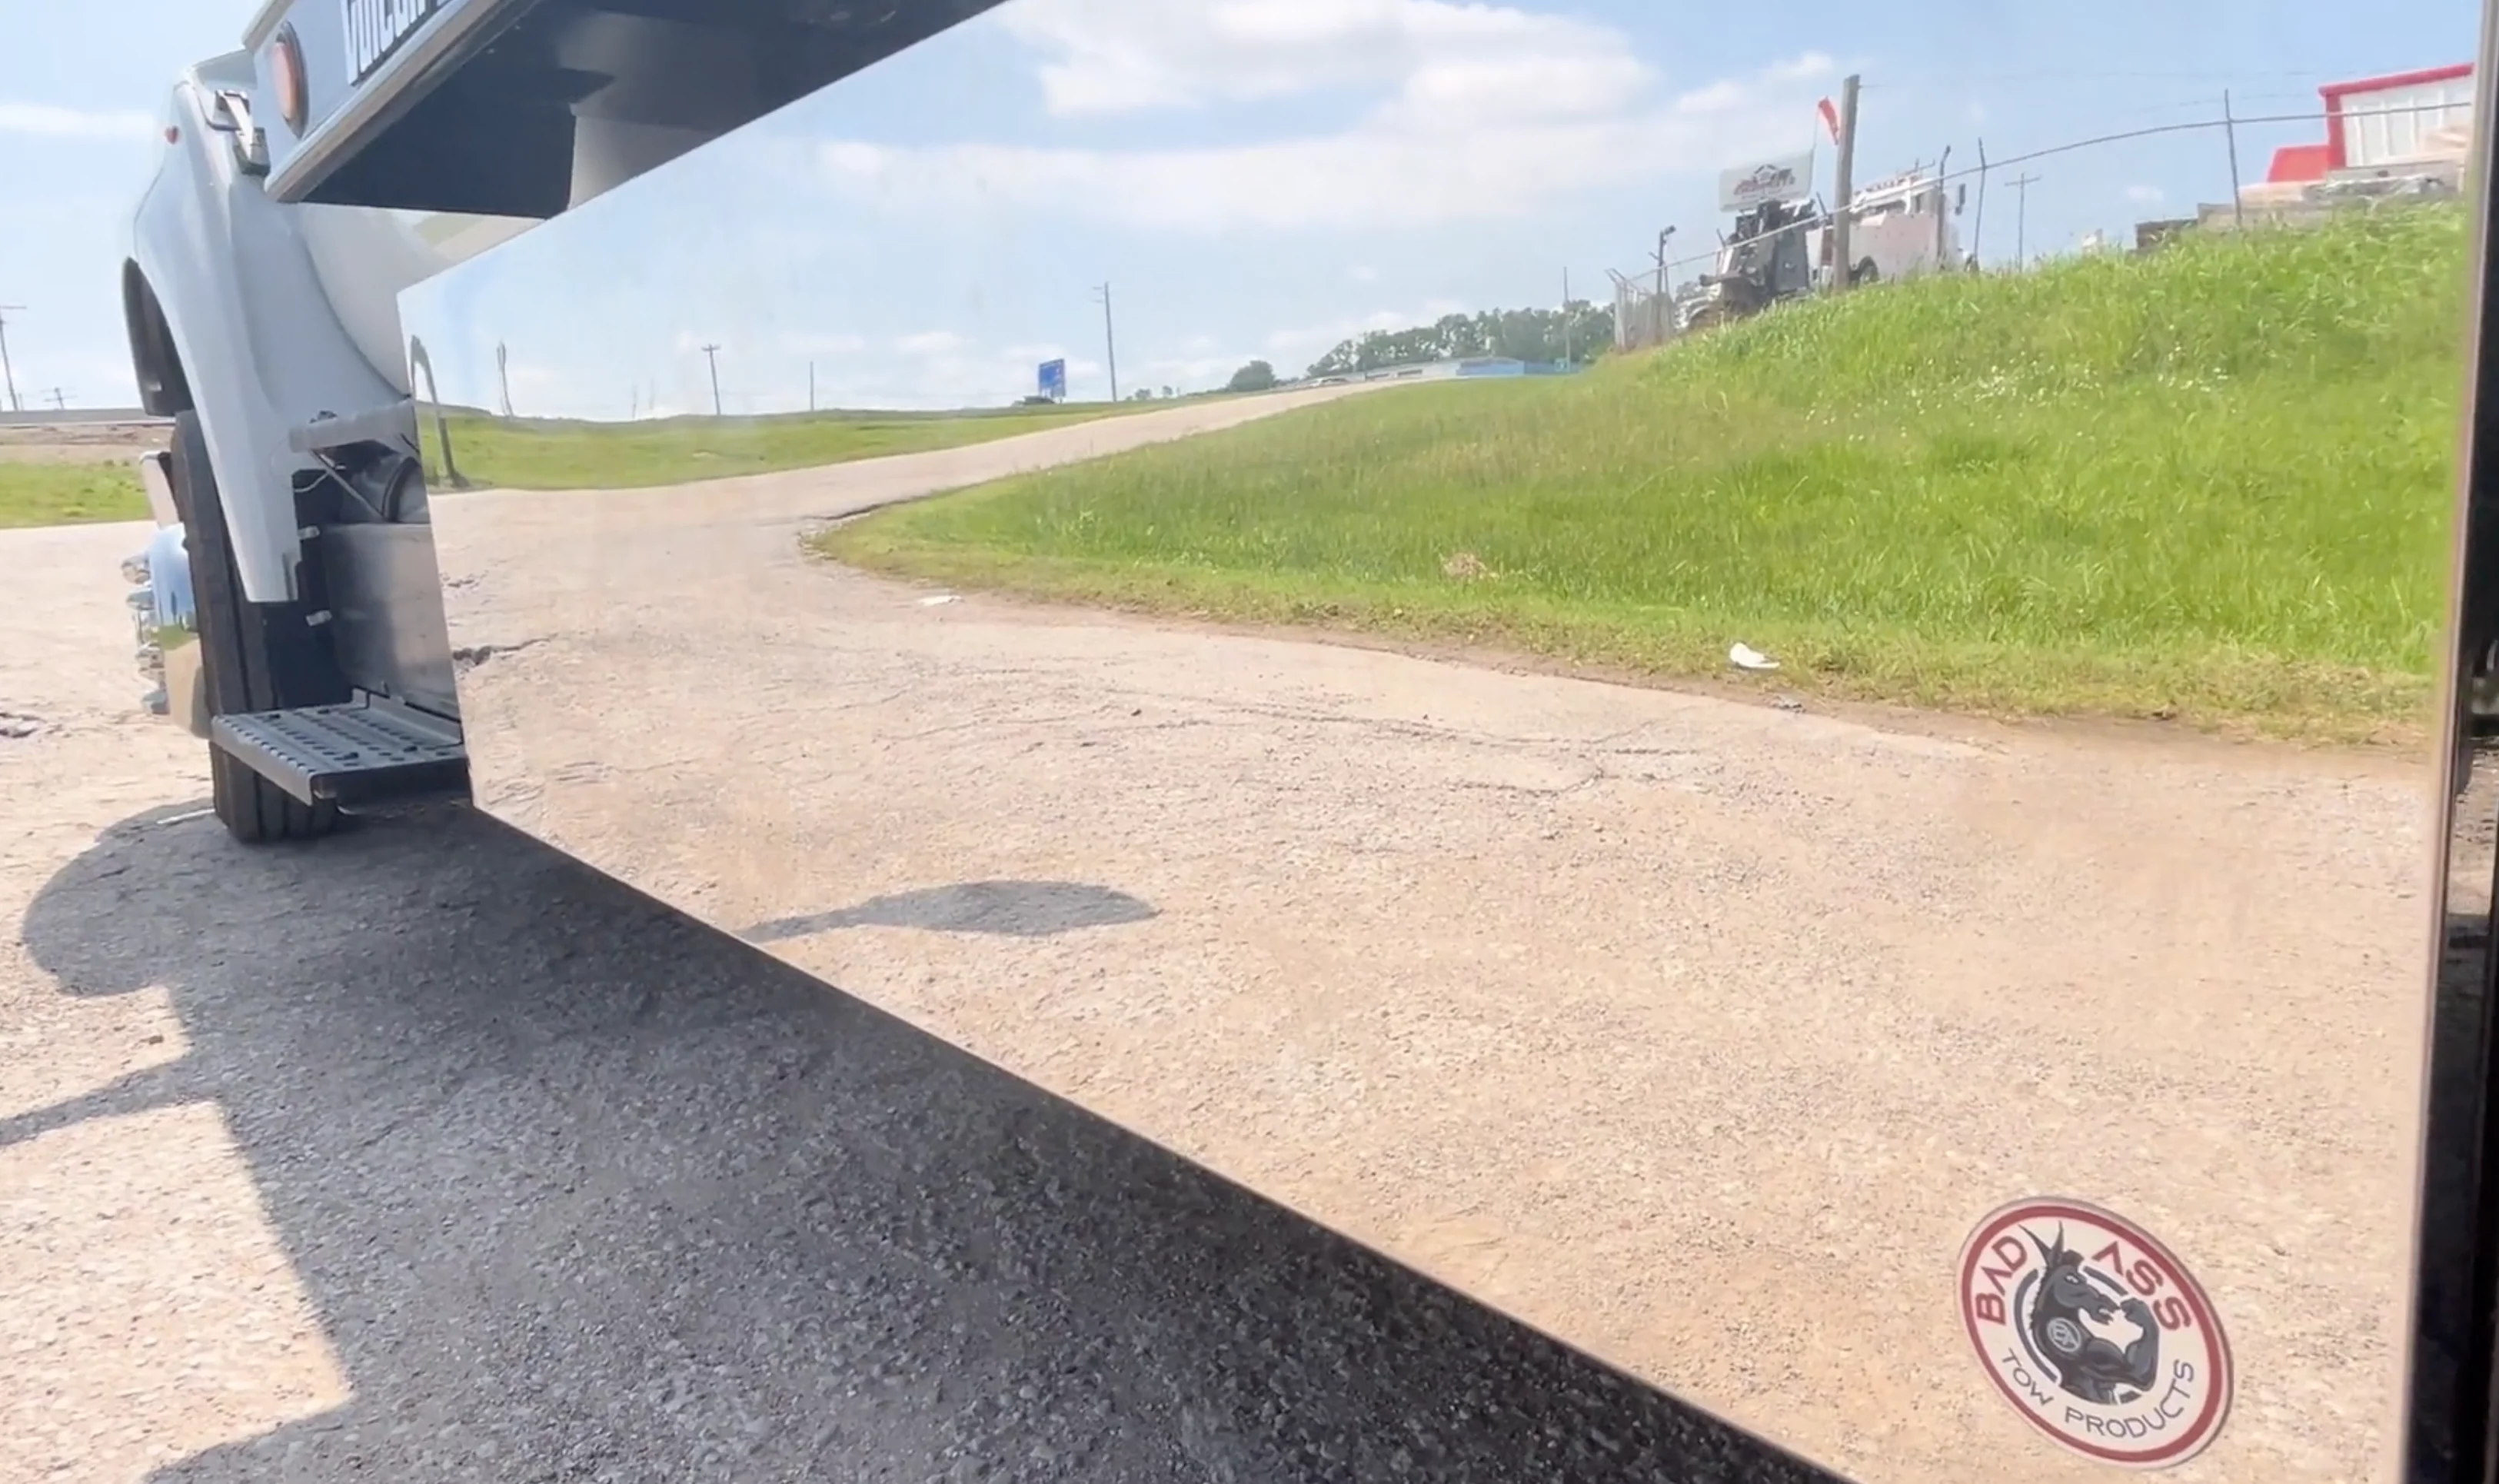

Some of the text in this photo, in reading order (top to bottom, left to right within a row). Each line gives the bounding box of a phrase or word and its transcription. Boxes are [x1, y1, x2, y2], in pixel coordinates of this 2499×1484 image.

[1975, 1235, 2192, 1331] BAD ASS
[2002, 1347, 2195, 1439] TOW PRODUCTS
